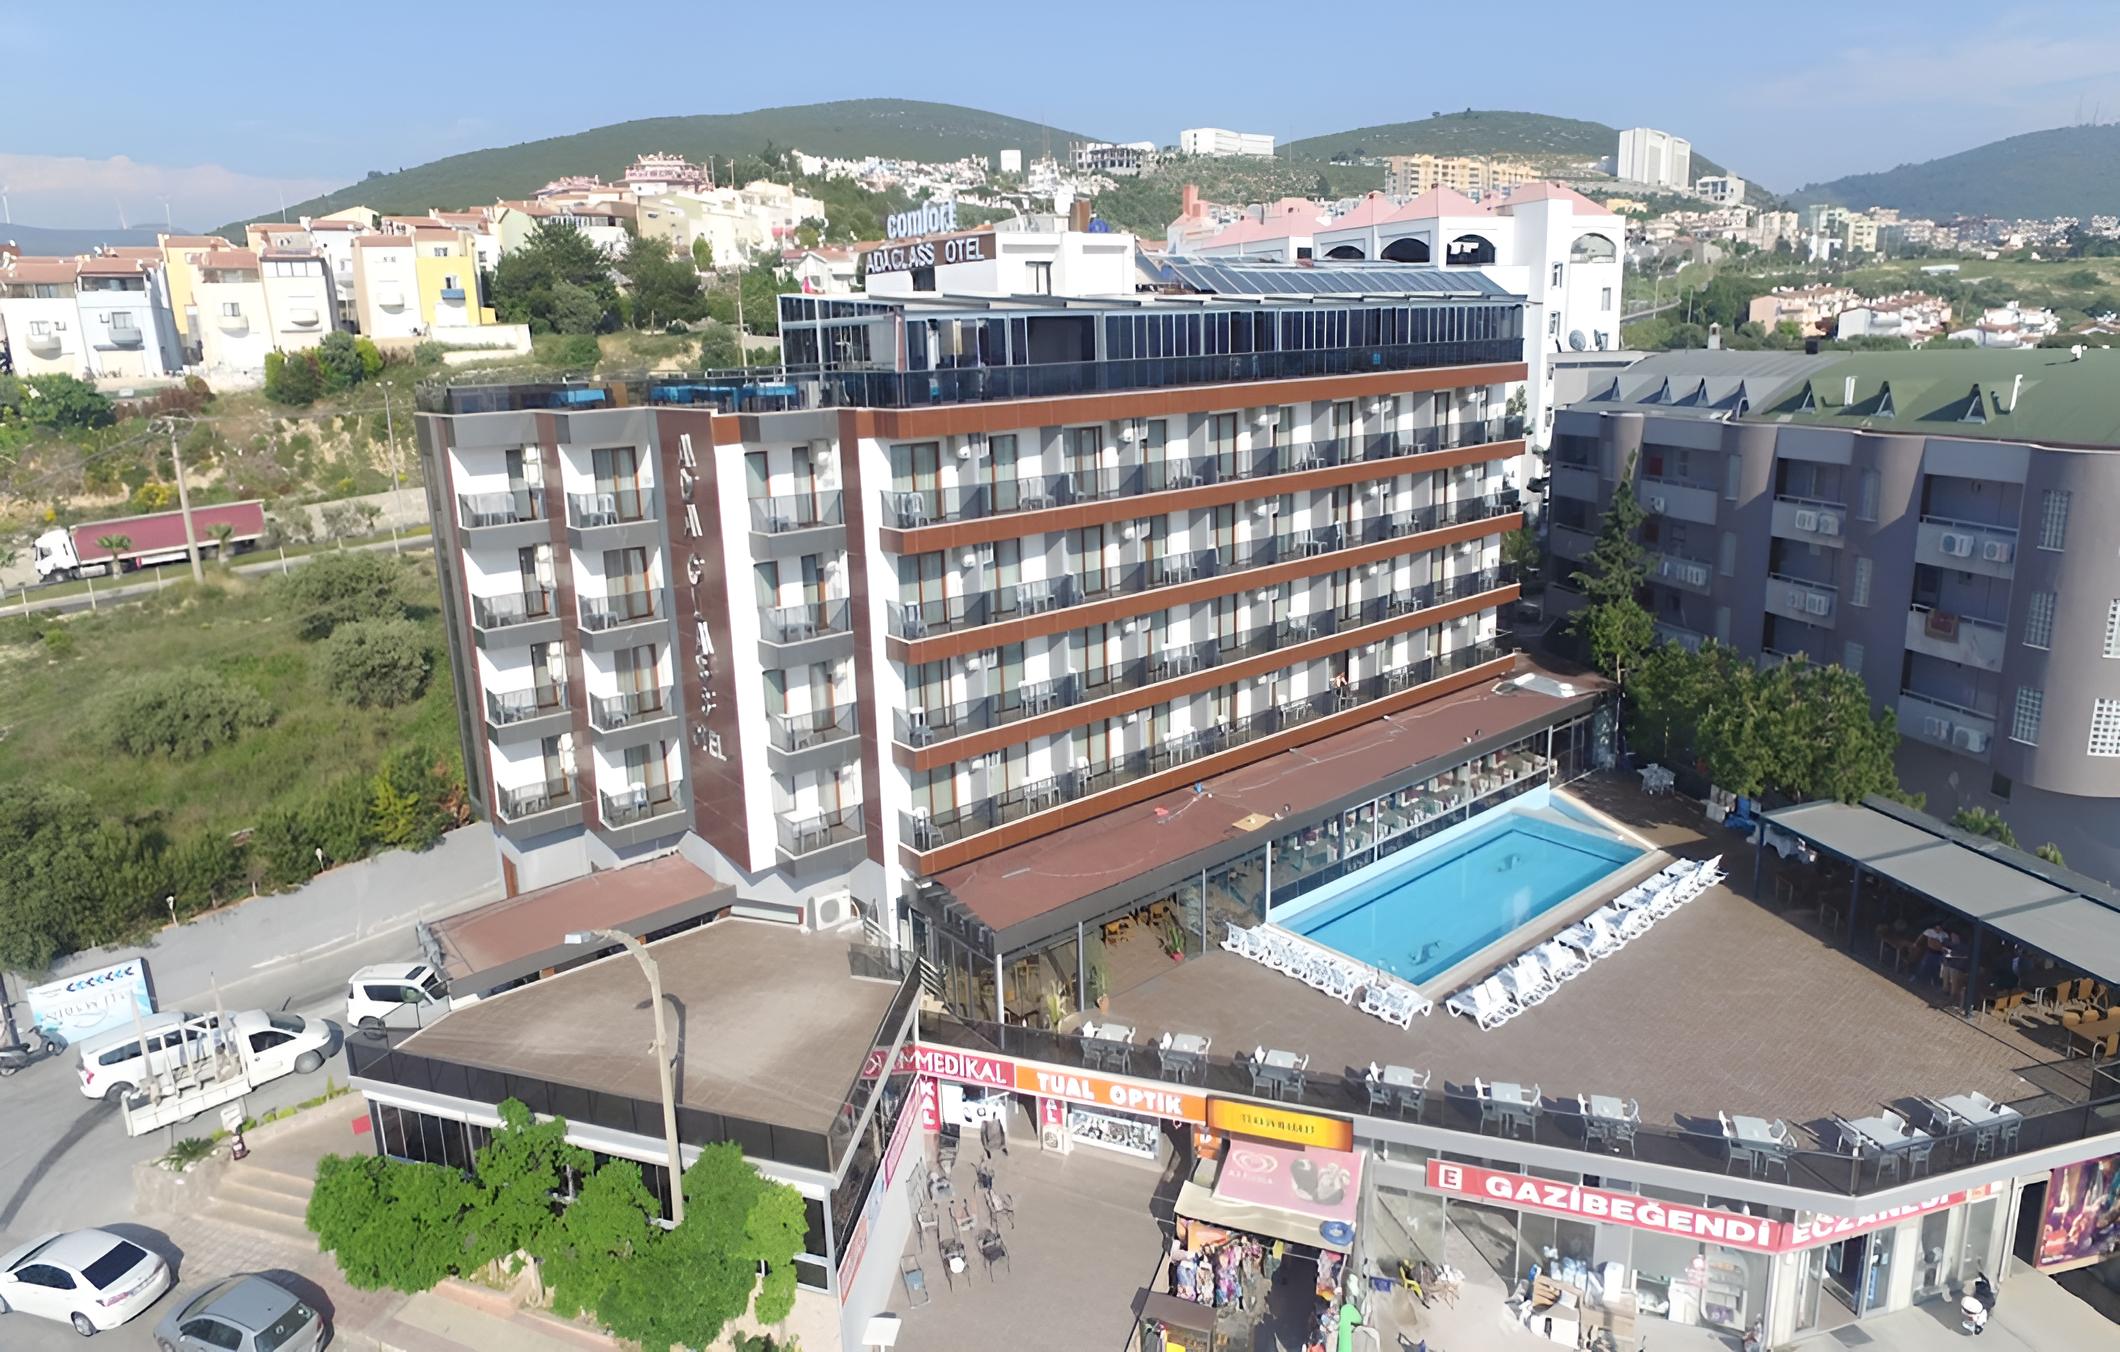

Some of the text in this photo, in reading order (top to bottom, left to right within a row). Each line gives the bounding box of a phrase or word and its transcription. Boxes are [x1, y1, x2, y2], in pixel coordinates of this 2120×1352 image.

[887, 199, 957, 240] comfort
[945, 237, 985, 264] OTEL
[1037, 1072, 1095, 1101] TUAL
[1485, 1174, 1771, 1247] GAZİBEĞENDİ
